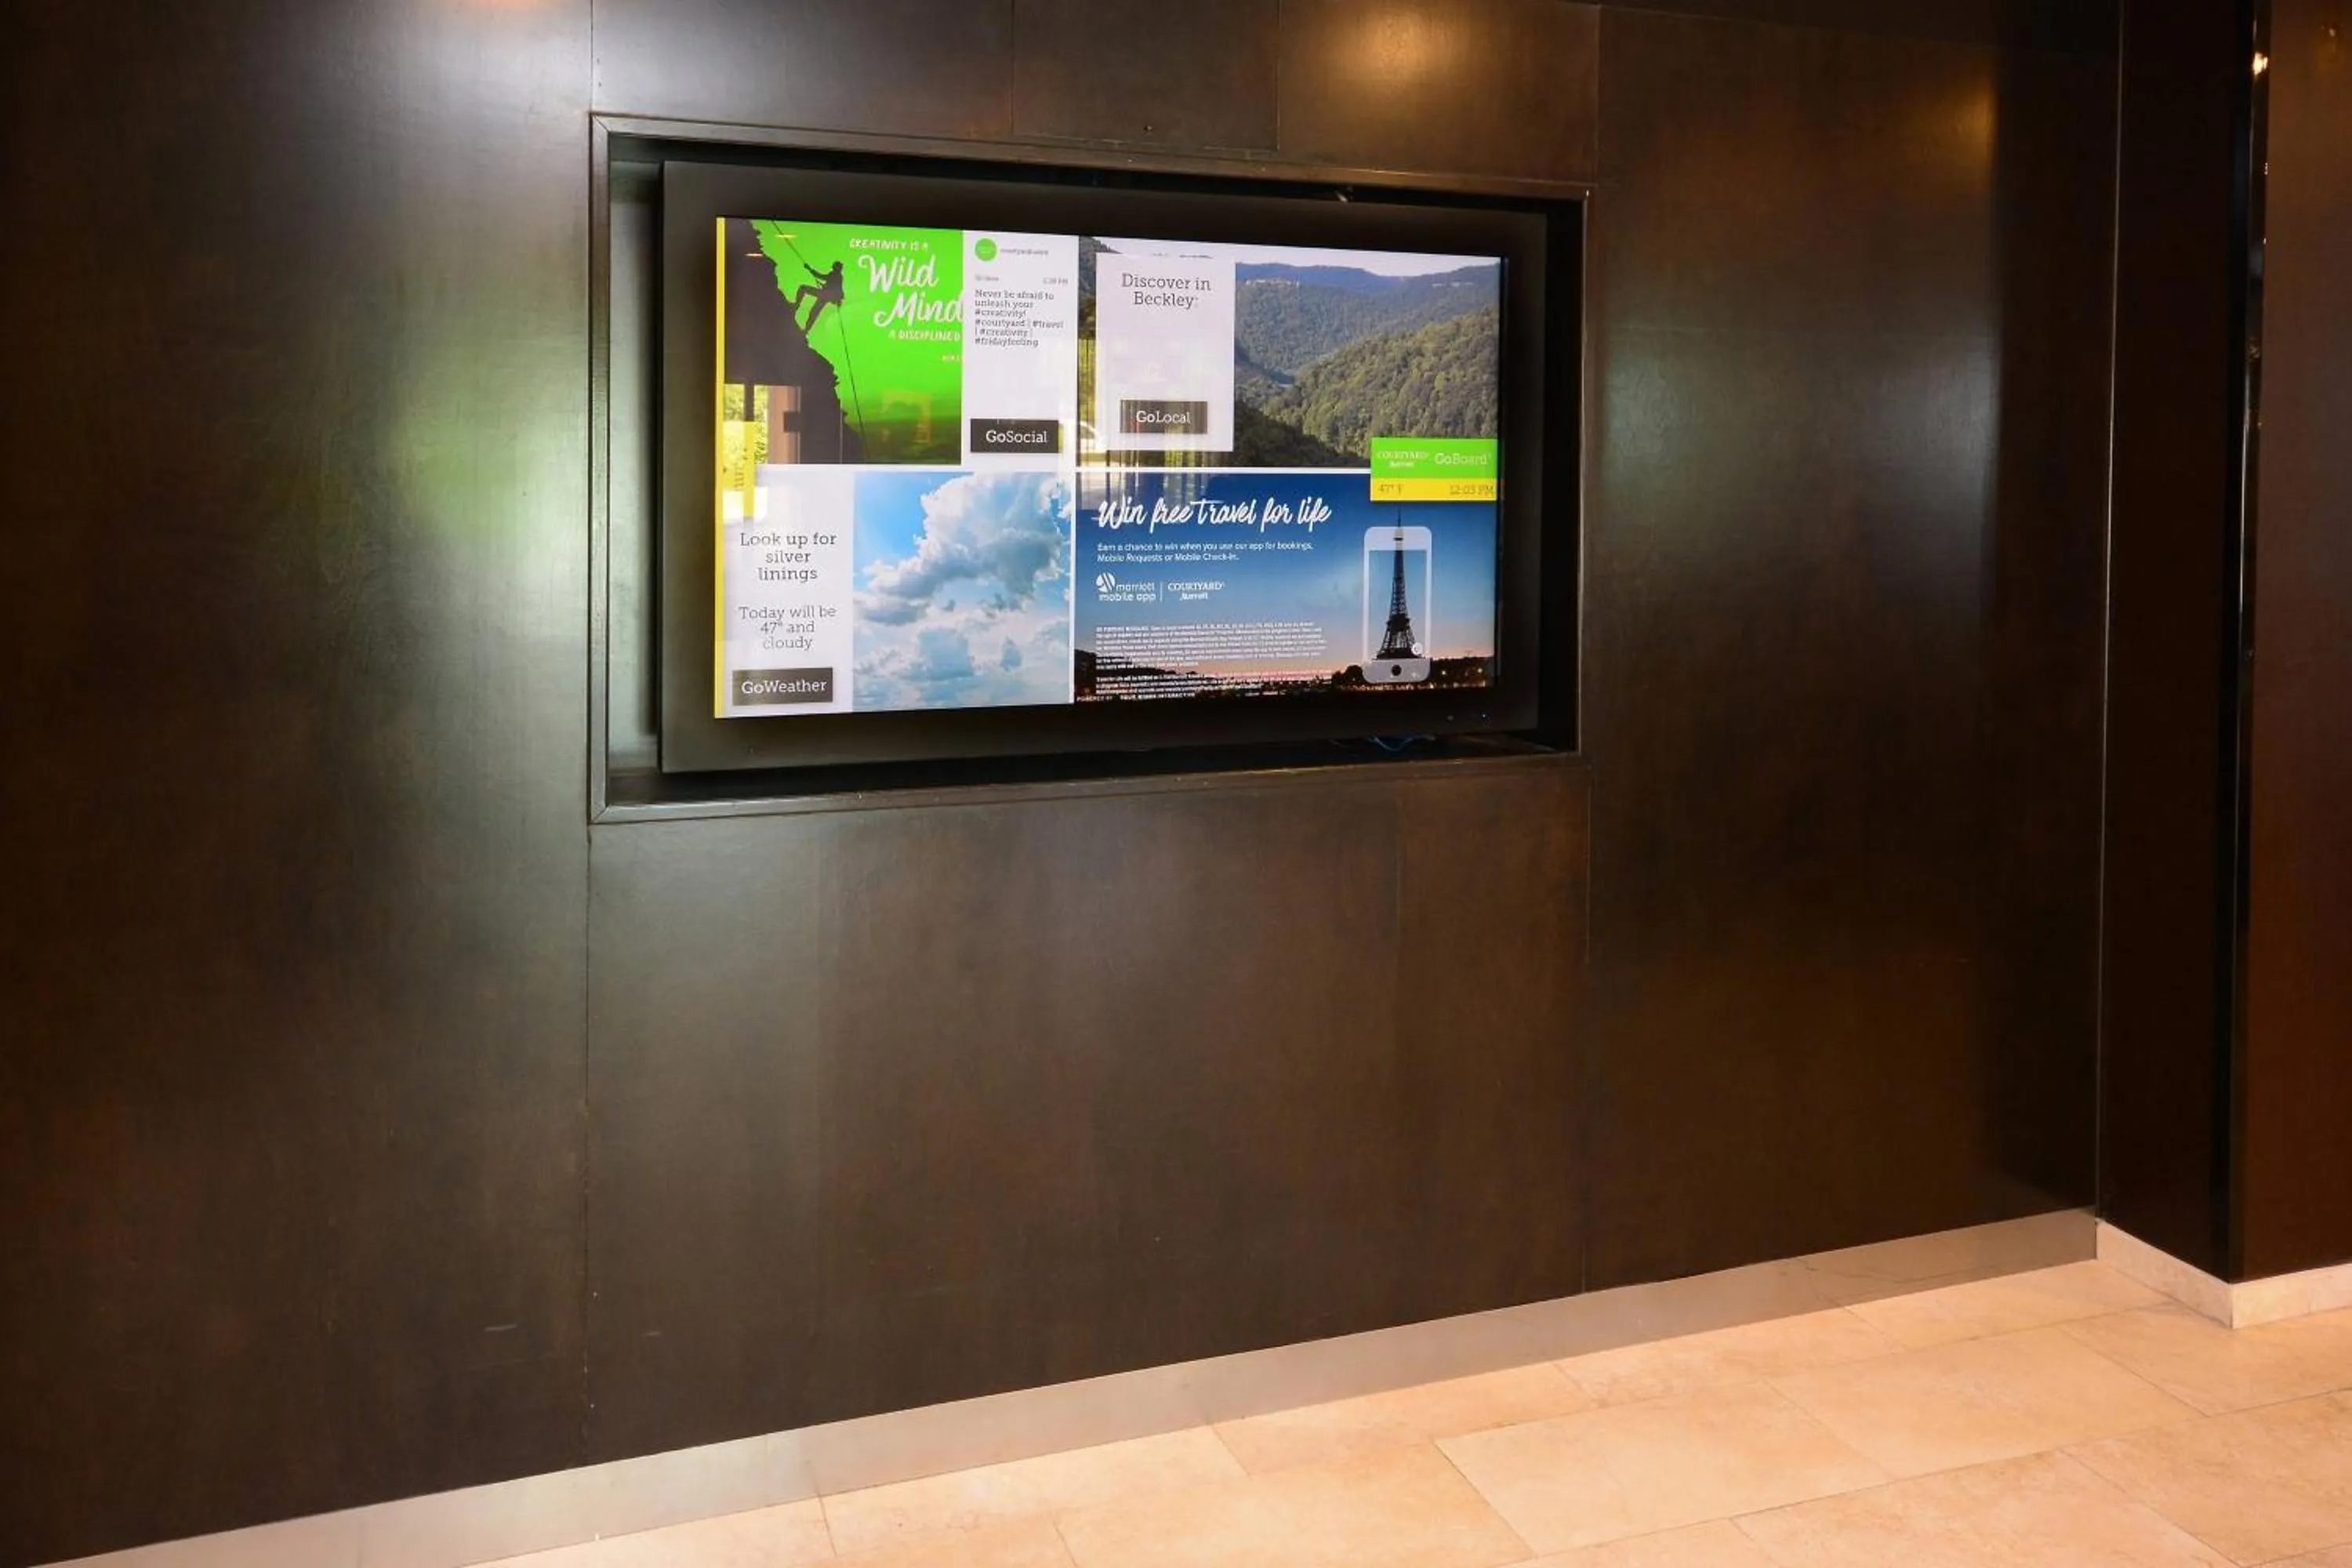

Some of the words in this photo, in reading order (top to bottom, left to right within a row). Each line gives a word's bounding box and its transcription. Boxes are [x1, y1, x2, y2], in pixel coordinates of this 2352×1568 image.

[858, 254, 939, 293] Wild
[1122, 273, 1191, 289] Discover
[1196, 277, 1211, 291] in
[975, 289, 1002, 298] Never
[873, 290, 970, 327] Mind
[975, 299, 1011, 307] unleash
[975, 319, 1025, 328] #courtyard
[1033, 320, 1065, 328] #travel
[980, 328, 1029, 337] #creativity
[975, 337, 1039, 347] #fridayfeeling
[1136, 410, 1192, 424] GoLocal
[985, 430, 1047, 443] GoSocial
[1092, 495, 1147, 529] Win
[1150, 497, 1194, 534] free
[1190, 498, 1257, 524] travel
[1260, 497, 1293, 532] for
[1297, 496, 1332, 532] life
[740, 532, 781, 546] Look
[786, 535, 808, 549] up
[813, 532, 837, 545] for
[1098, 542, 1116, 551] Earn
[1125, 542, 1153, 551] chance
[1155, 543, 1162, 551] to
[1164, 542, 1178, 550] win
[1180, 542, 1202, 550] when
[1249, 543, 1265, 551] app
[1265, 541, 1276, 550] for
[765, 550, 811, 563] silver
[1098, 554, 1125, 562] Mobile
[1127, 554, 1163, 563] Requests
[1175, 553, 1201, 561] Mobile
[757, 567, 818, 583] linings
[1116, 583, 1155, 591] marriott
[1099, 593, 1134, 601] mobile
[1136, 593, 1156, 603] app
[739, 606, 785, 621] Today
[789, 604, 815, 619] will
[819, 604, 837, 618] be
[760, 622, 782, 634] 47°
[787, 621, 815, 633] and
[763, 637, 813, 651] cloudy
[742, 679, 827, 694] GoWeather
